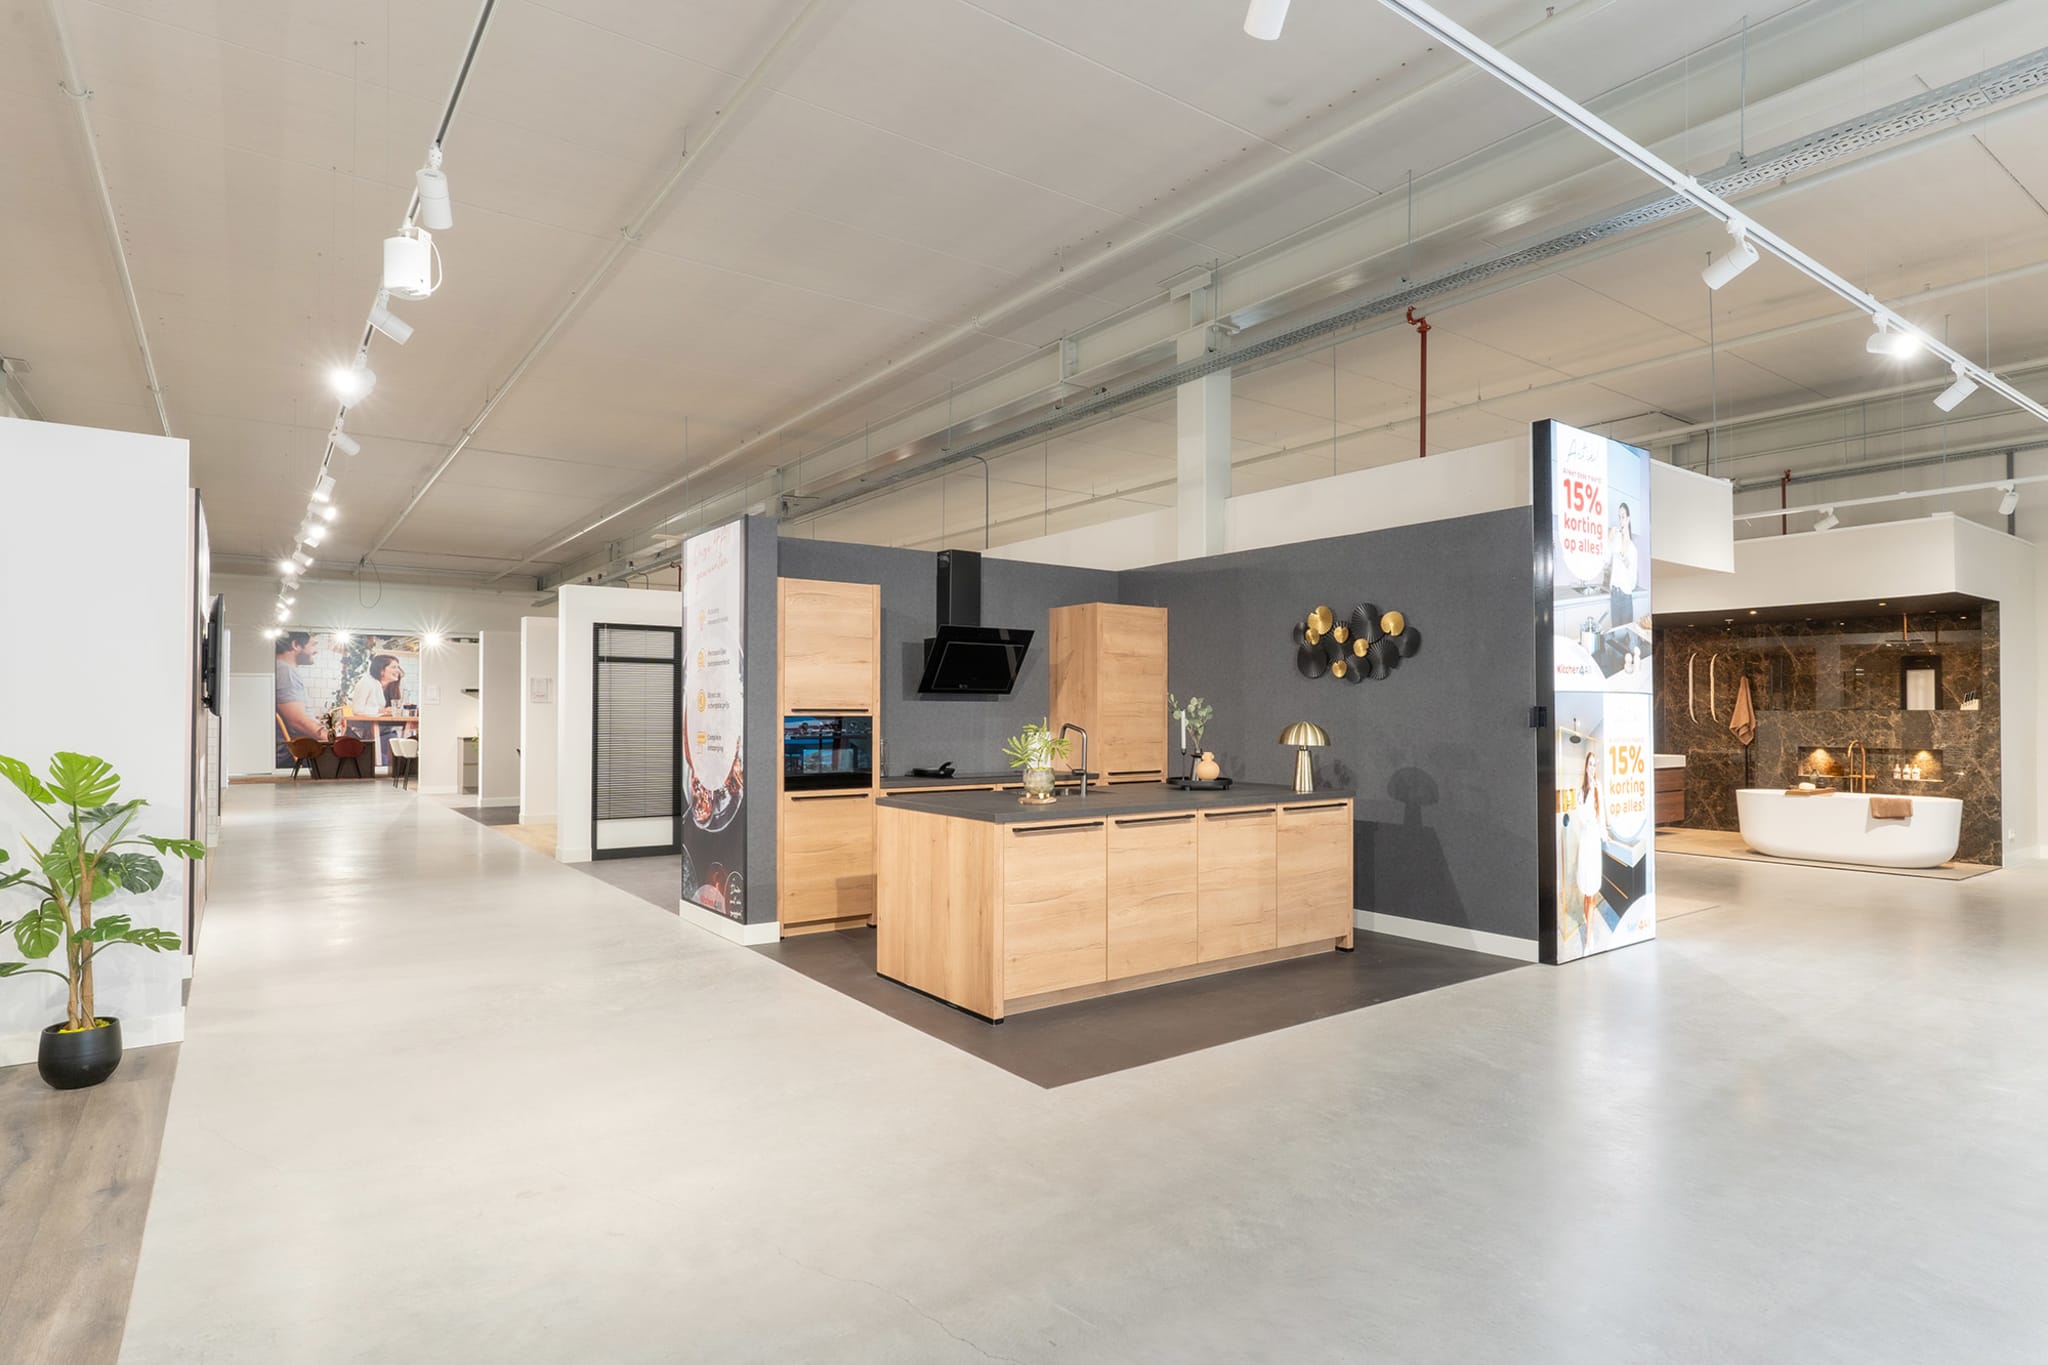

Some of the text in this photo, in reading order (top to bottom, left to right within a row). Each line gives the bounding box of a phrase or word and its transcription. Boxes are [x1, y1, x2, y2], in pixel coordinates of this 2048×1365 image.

[1563, 478, 1602, 516] 15%
[1564, 512, 1603, 540] korting
[1564, 538, 1603, 556] op alles!
[1609, 745, 1645, 775] 15%
[1609, 777, 1645, 797] korting
[1609, 799, 1646, 816] op alles!
